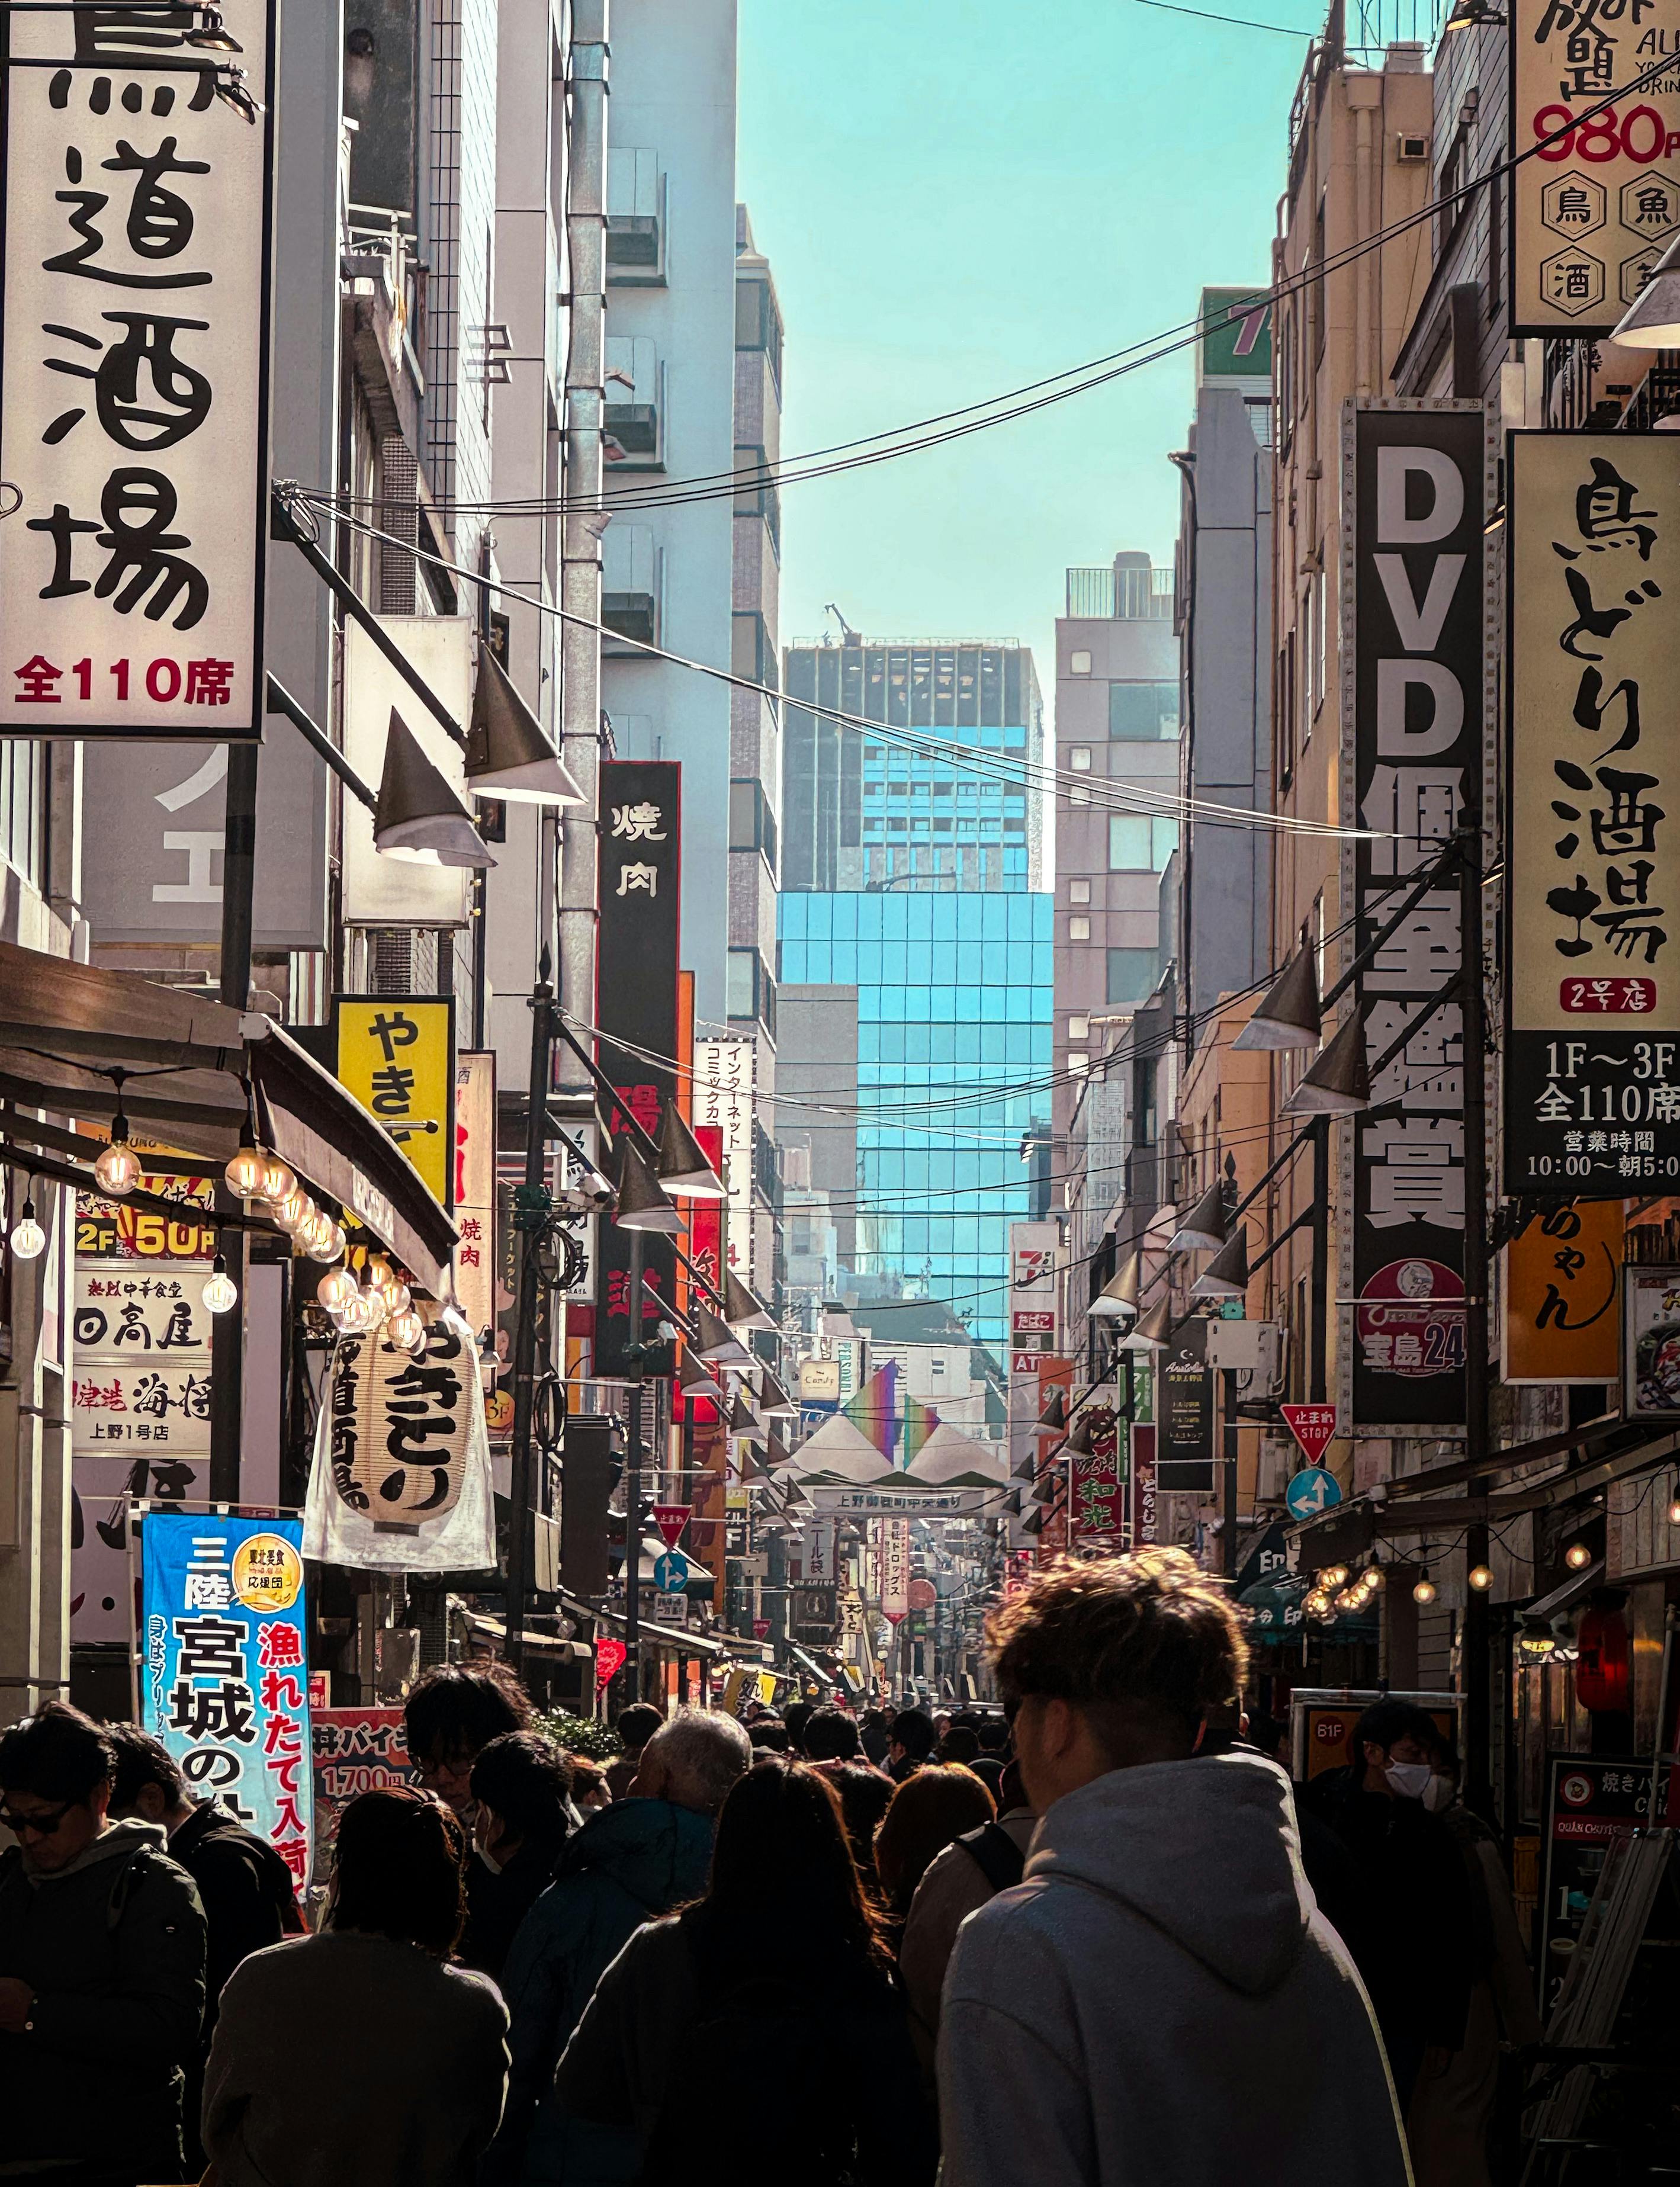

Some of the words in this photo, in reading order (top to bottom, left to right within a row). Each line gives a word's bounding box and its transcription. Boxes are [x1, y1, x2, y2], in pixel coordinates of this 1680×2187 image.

[1557, 187, 1591, 223] 鳥
[1636, 187, 1670, 223] 魚
[1555, 264, 1589, 297] 酒
[14, 654, 234, 706] 全110席
[1546, 457, 1667, 964] 鳥どり酒場
[611, 802, 667, 897] 焼肉
[1570, 980, 1648, 1011] 2号店
[368, 1011, 418, 1148] やき
[707, 1047, 719, 1126] コミックカ
[727, 1047, 741, 1148] インターネット
[1534, 1081, 1680, 1124] 全110席
[1563, 1131, 1655, 1152] 営業時間
[1528, 1155, 1680, 1177] 10:00〜朝5:0
[76, 1223, 115, 1251] 2F
[460, 1218, 482, 1267] 焼肉
[73, 1301, 203, 1350] 日高屋
[1363, 1322, 1465, 1367] 宝島24
[1016, 1355, 1052, 1371] AT
[89, 1422, 169, 1440] 上野1号店
[381, 1319, 462, 1511] やきとり
[487, 1401, 510, 1421] 3F
[1301, 1427, 1329, 1439] STOP
[185, 1537, 231, 1612] 三陸
[258, 1623, 307, 1897] 漁れたて入荷
